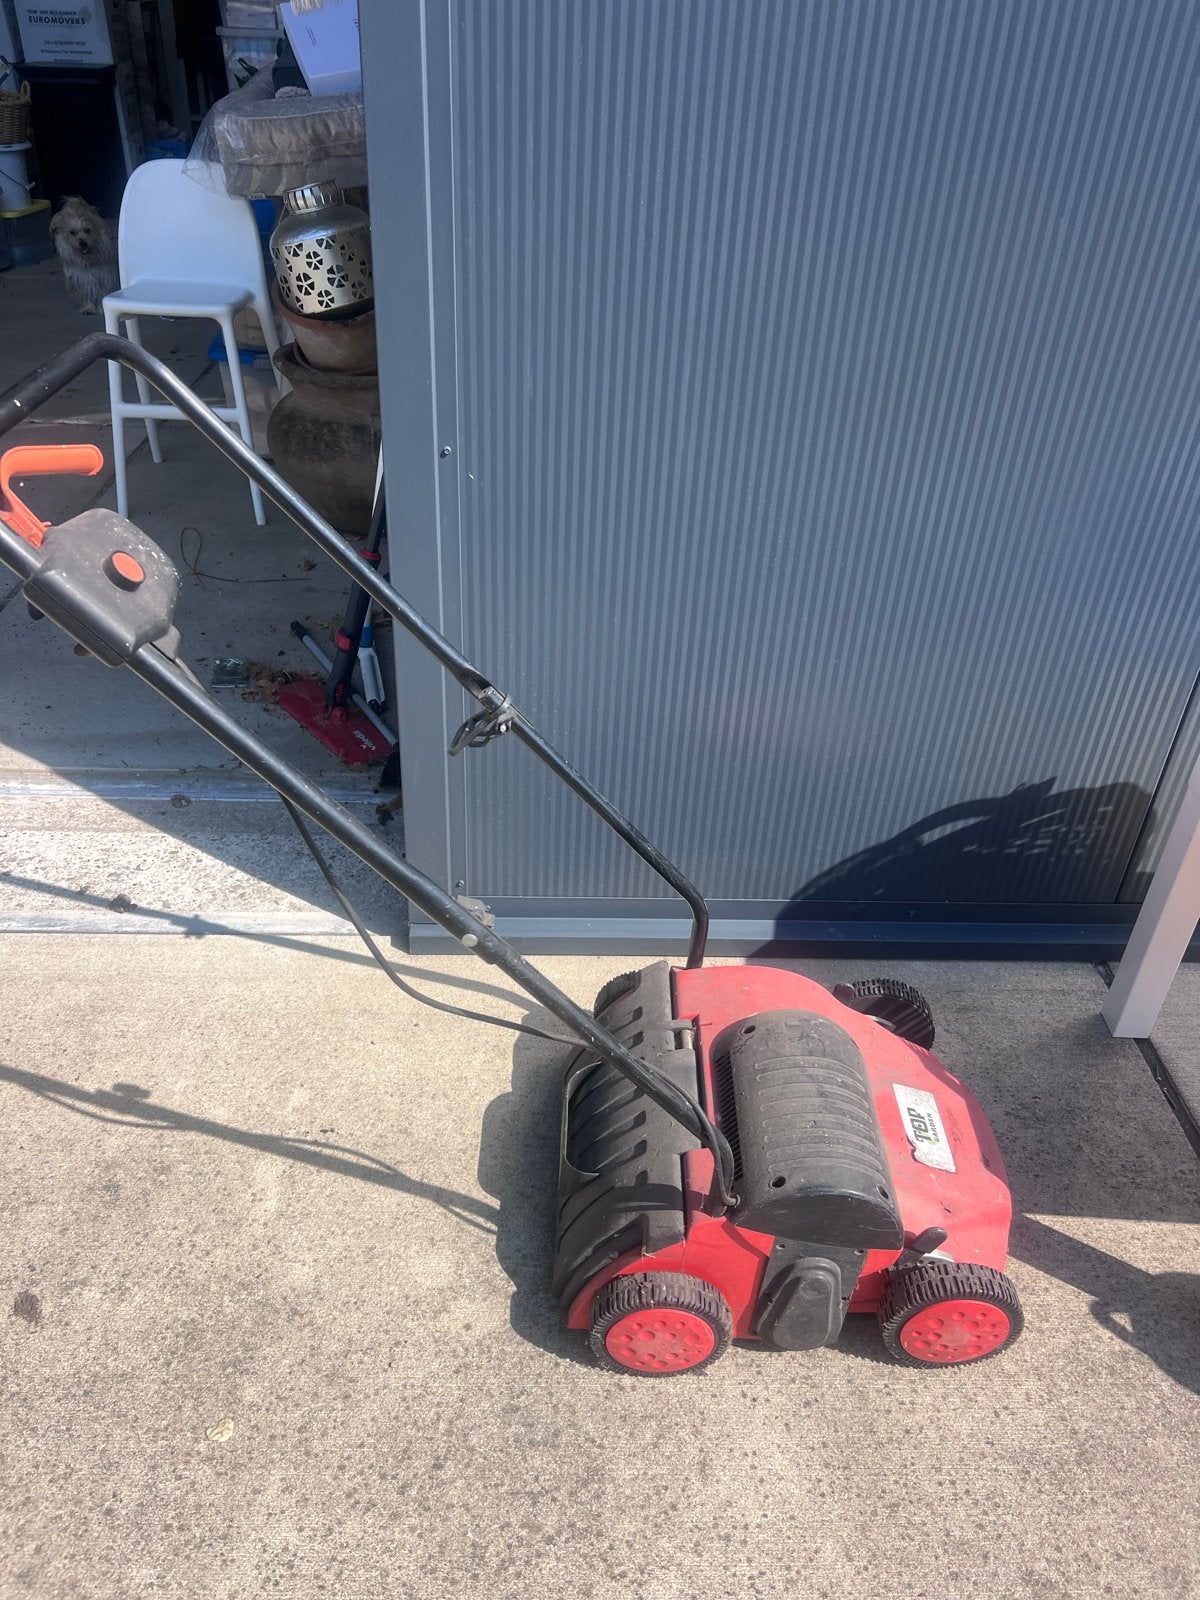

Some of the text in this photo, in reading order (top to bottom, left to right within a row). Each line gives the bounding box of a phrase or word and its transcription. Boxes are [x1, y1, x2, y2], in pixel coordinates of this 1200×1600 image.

[28, 15, 86, 25] EUROMOVERS
[907, 1107, 931, 1143] TOP
[927, 1112, 940, 1143] GARDEN
